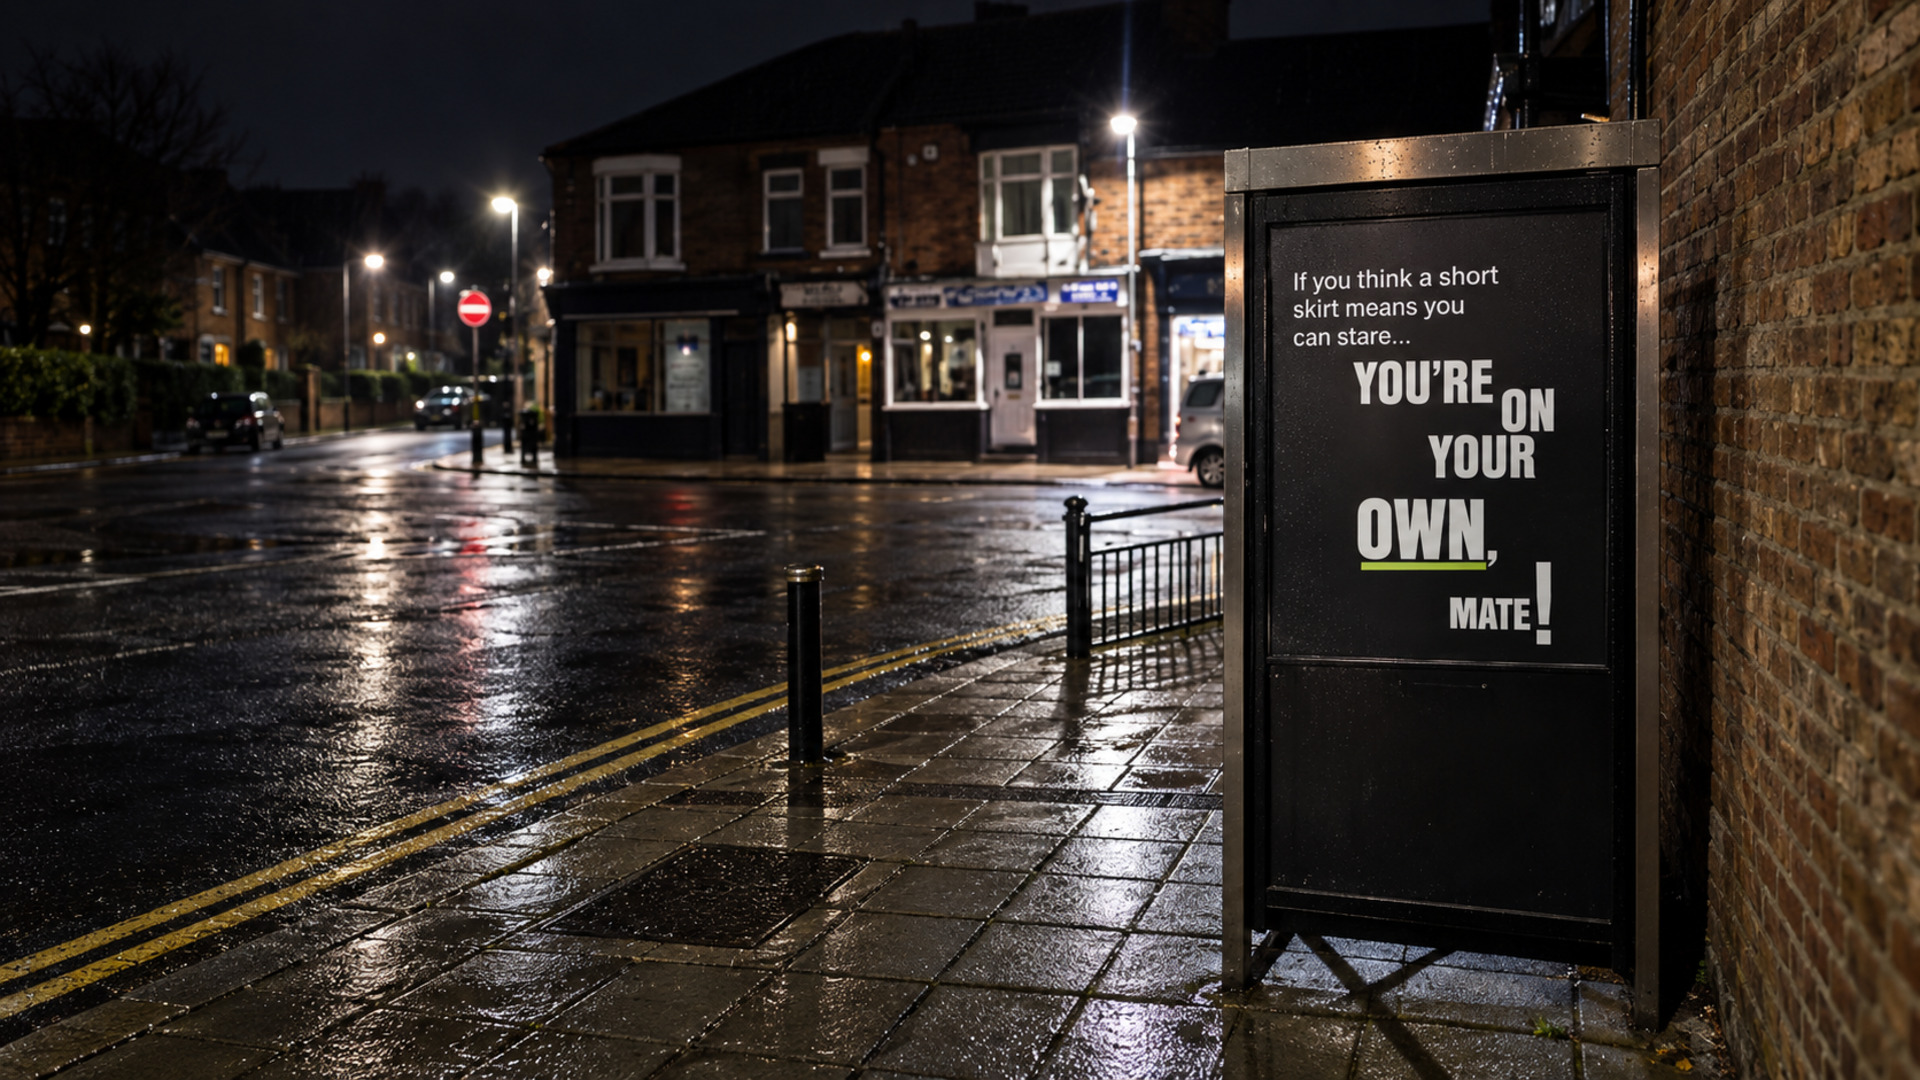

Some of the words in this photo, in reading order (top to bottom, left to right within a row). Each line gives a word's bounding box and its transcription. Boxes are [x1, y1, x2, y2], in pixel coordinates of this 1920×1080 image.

[1293, 271, 1308, 291] If
[1312, 274, 1351, 298] you
[1356, 268, 1413, 289] think
[1418, 271, 1433, 288] a
[1439, 265, 1500, 288] short
[1293, 299, 1340, 319] skirt
[1345, 301, 1418, 318] means
[1423, 299, 1465, 321] you
[1293, 332, 1331, 348] can
[1337, 329, 1411, 347] stare...
[1352, 359, 1494, 406] YOU’RE
[1501, 388, 1555, 433] ON
[1427, 434, 1536, 479] YOUR
[1357, 497, 1498, 567] OWN,
[1449, 561, 1552, 646] MATE!
